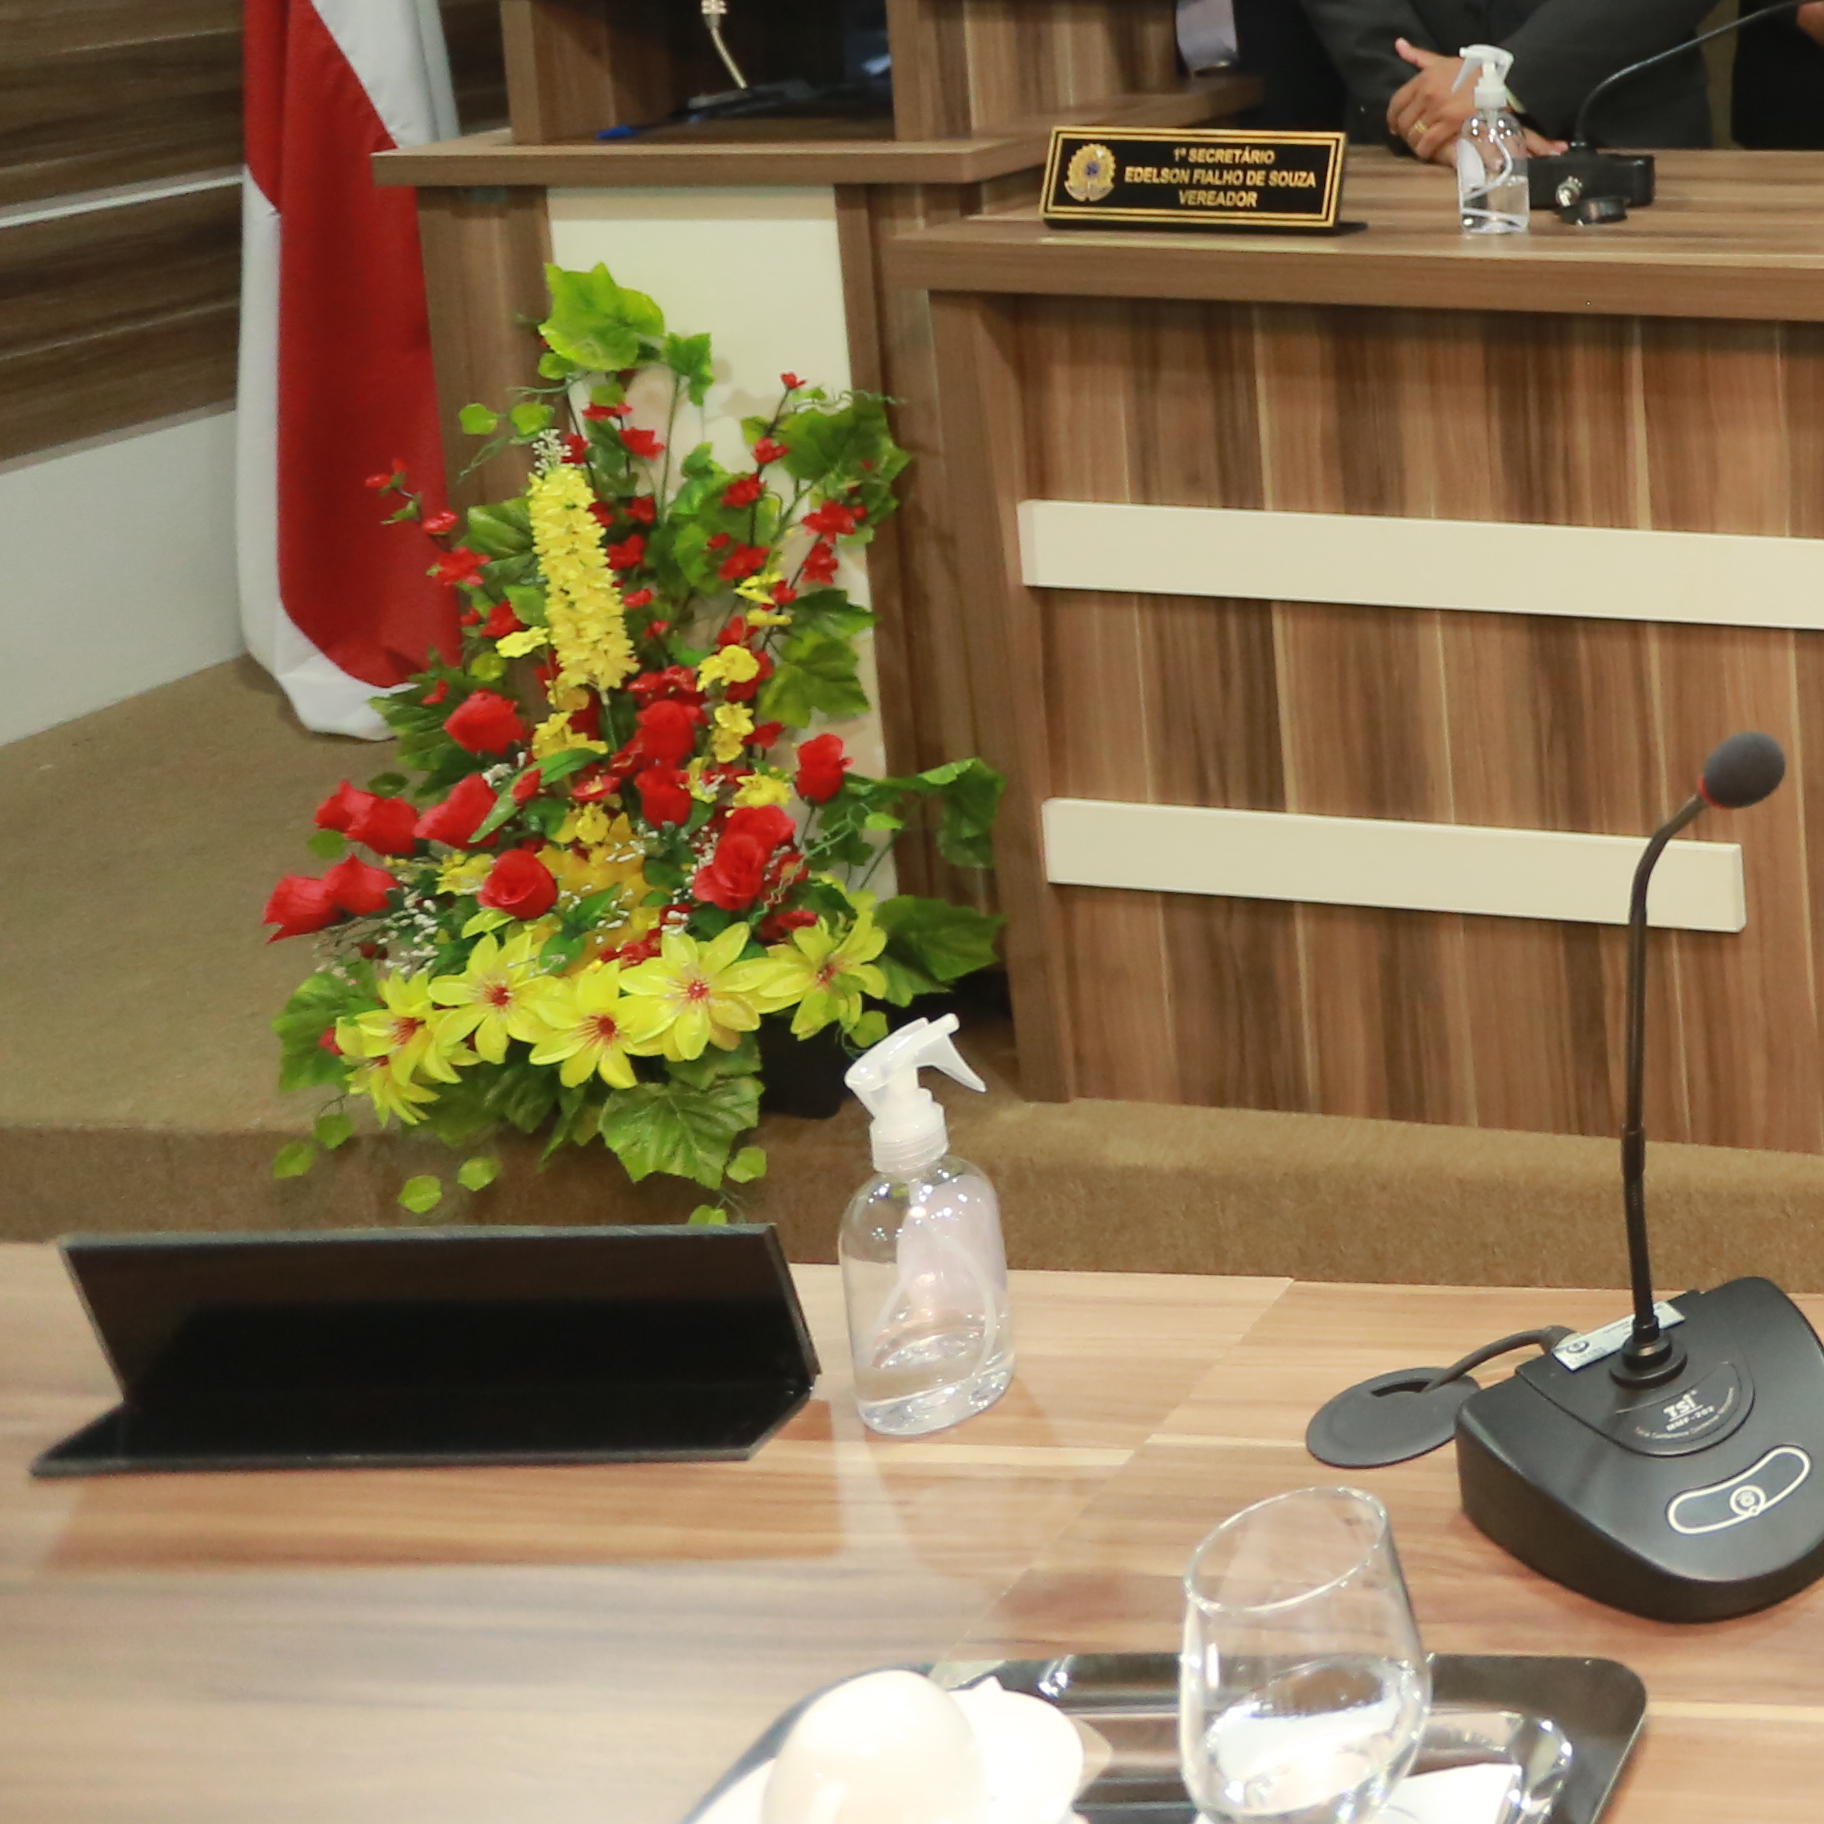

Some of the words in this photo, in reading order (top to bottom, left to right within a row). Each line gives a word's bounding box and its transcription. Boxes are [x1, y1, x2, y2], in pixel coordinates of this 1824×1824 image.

[1188, 146, 1276, 165] SECRETÁRIO
[1124, 166, 1190, 184] EDELSON
[1192, 168, 1243, 186] FIALHO
[1245, 170, 1266, 187] DE
[1268, 170, 1316, 188] SOUZA
[1178, 189, 1258, 208] VEREADOR
